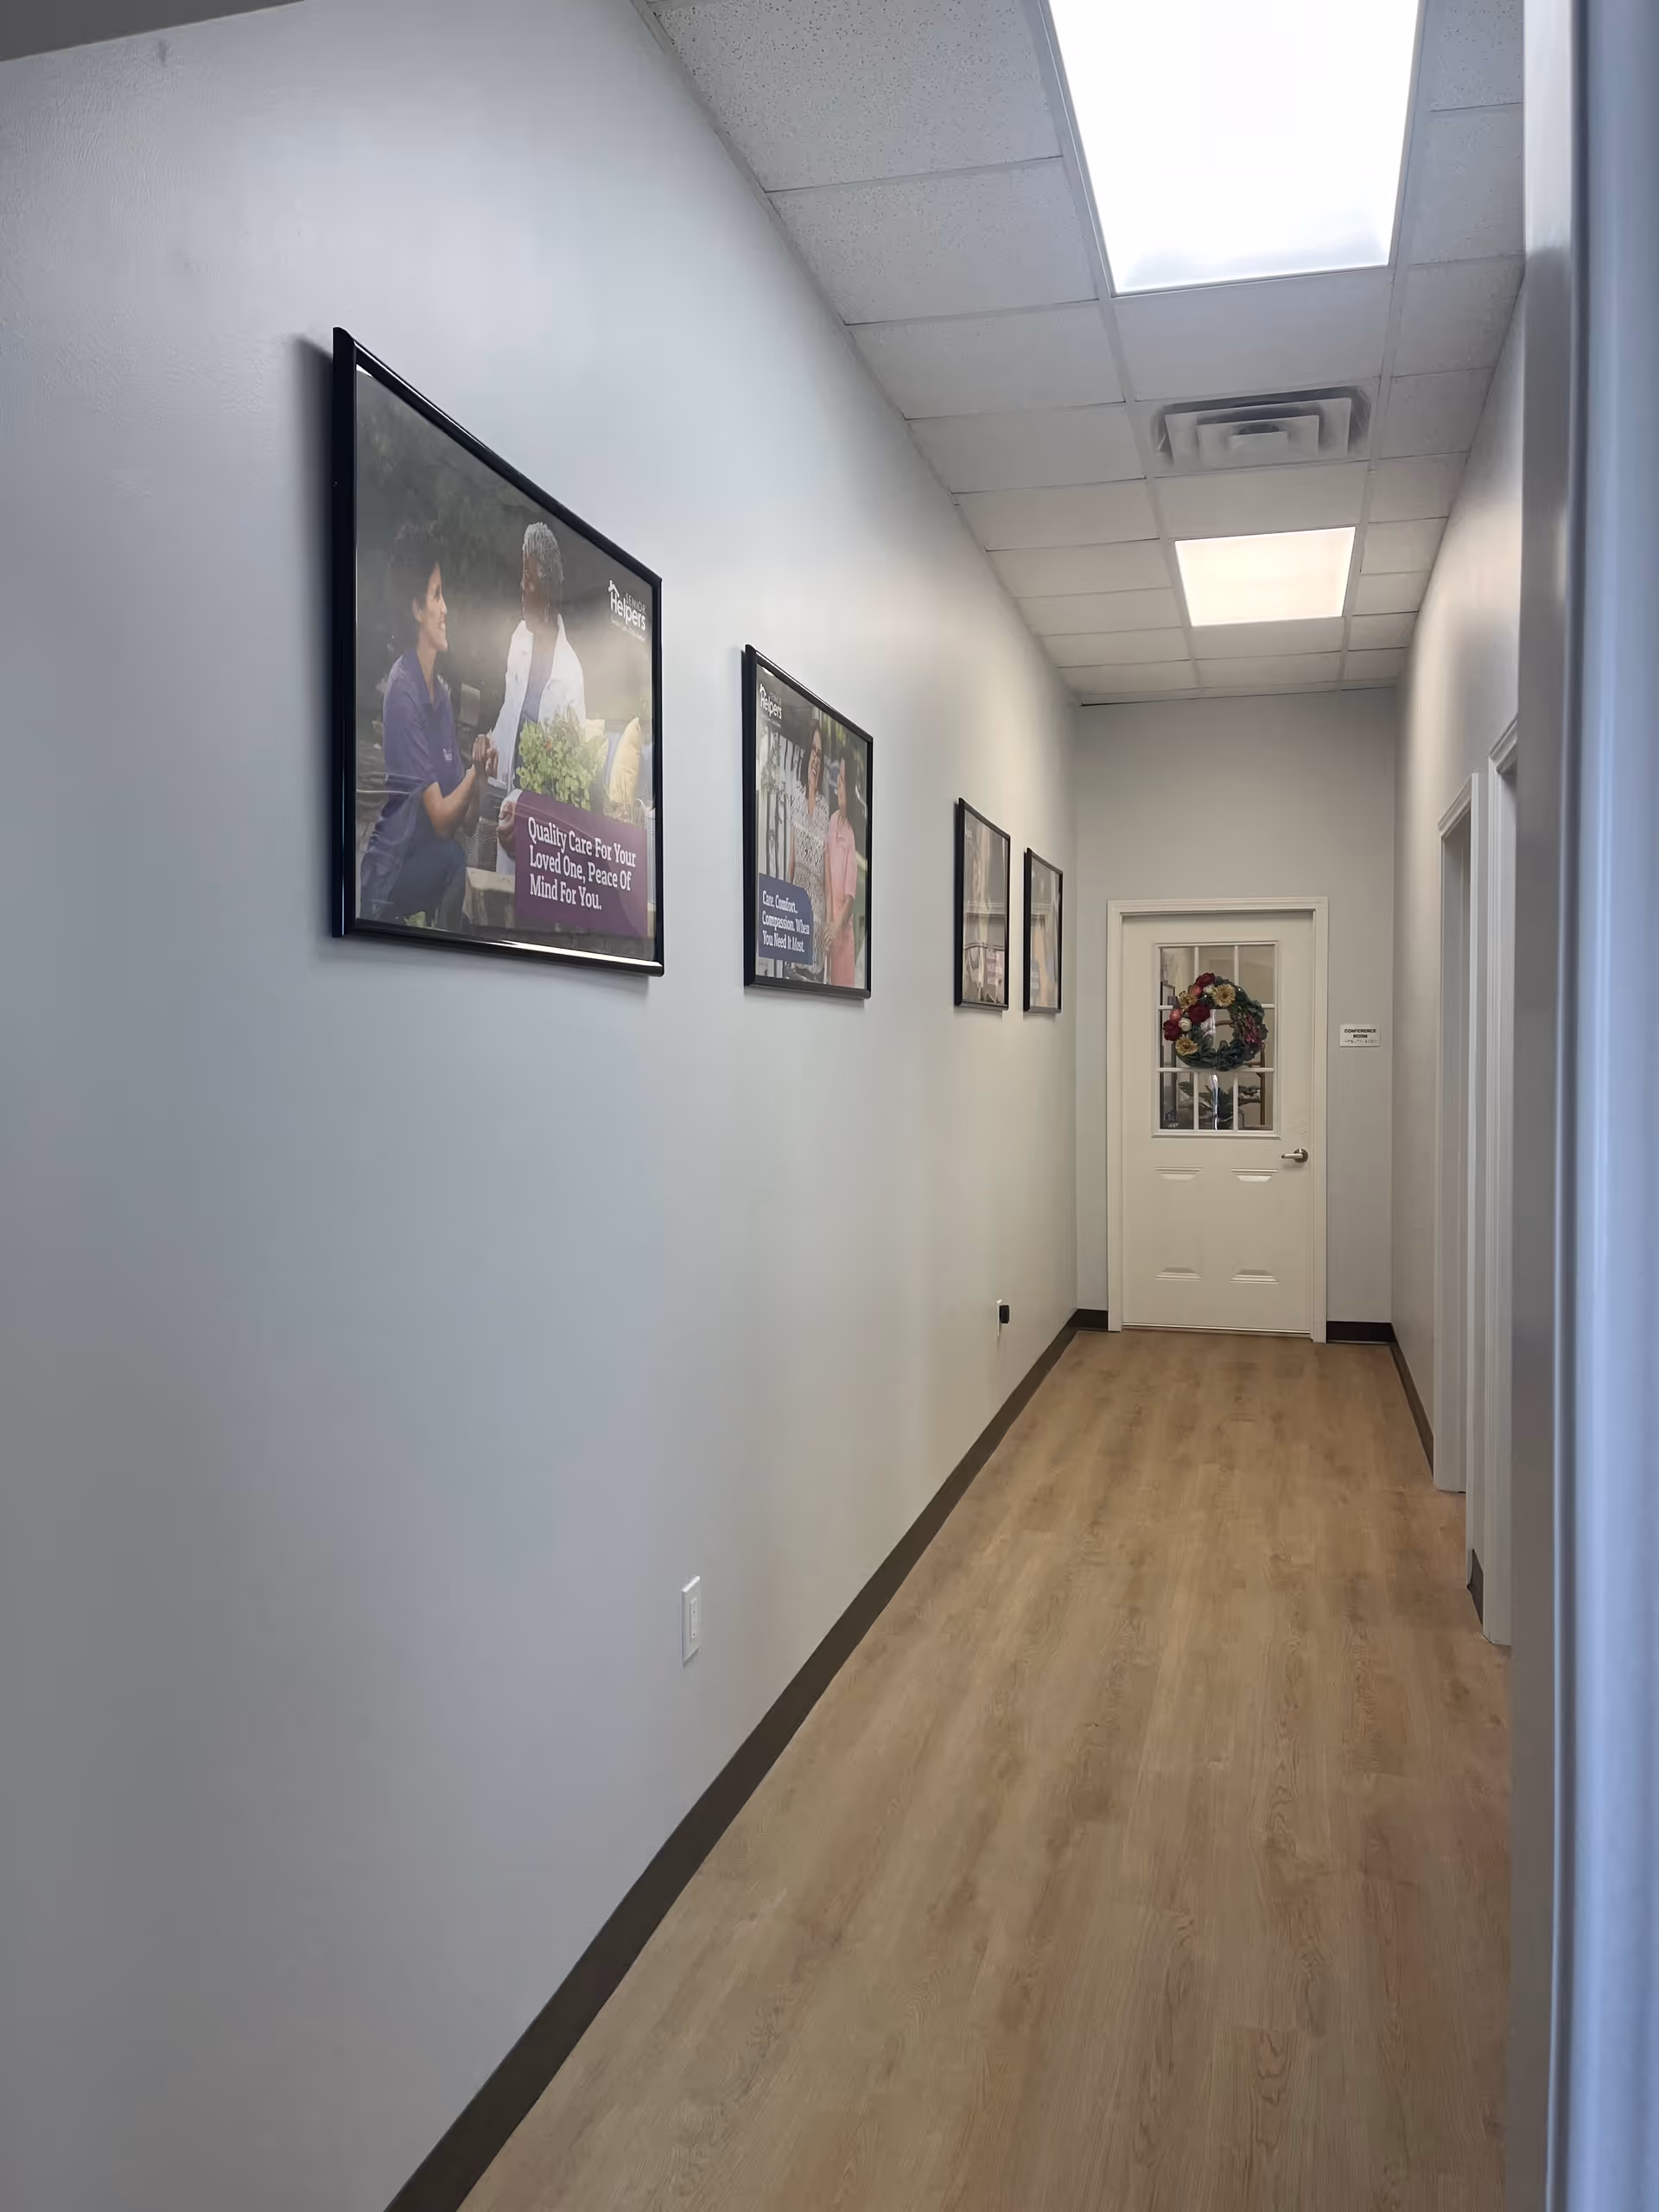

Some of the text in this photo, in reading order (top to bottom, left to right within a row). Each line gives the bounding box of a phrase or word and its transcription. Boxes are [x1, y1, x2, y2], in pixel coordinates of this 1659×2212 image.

[610, 590, 646, 631] Helpers
[528, 817, 637, 868] Quality Care For Your
[529, 844, 632, 891] Loved One, Peace Of
[530, 873, 602, 910] Mind For You.
[762, 890, 798, 913] Care. Comfort.
[761, 910, 810, 935] Compassion. When
[762, 930, 805, 953] You Need It Most.
